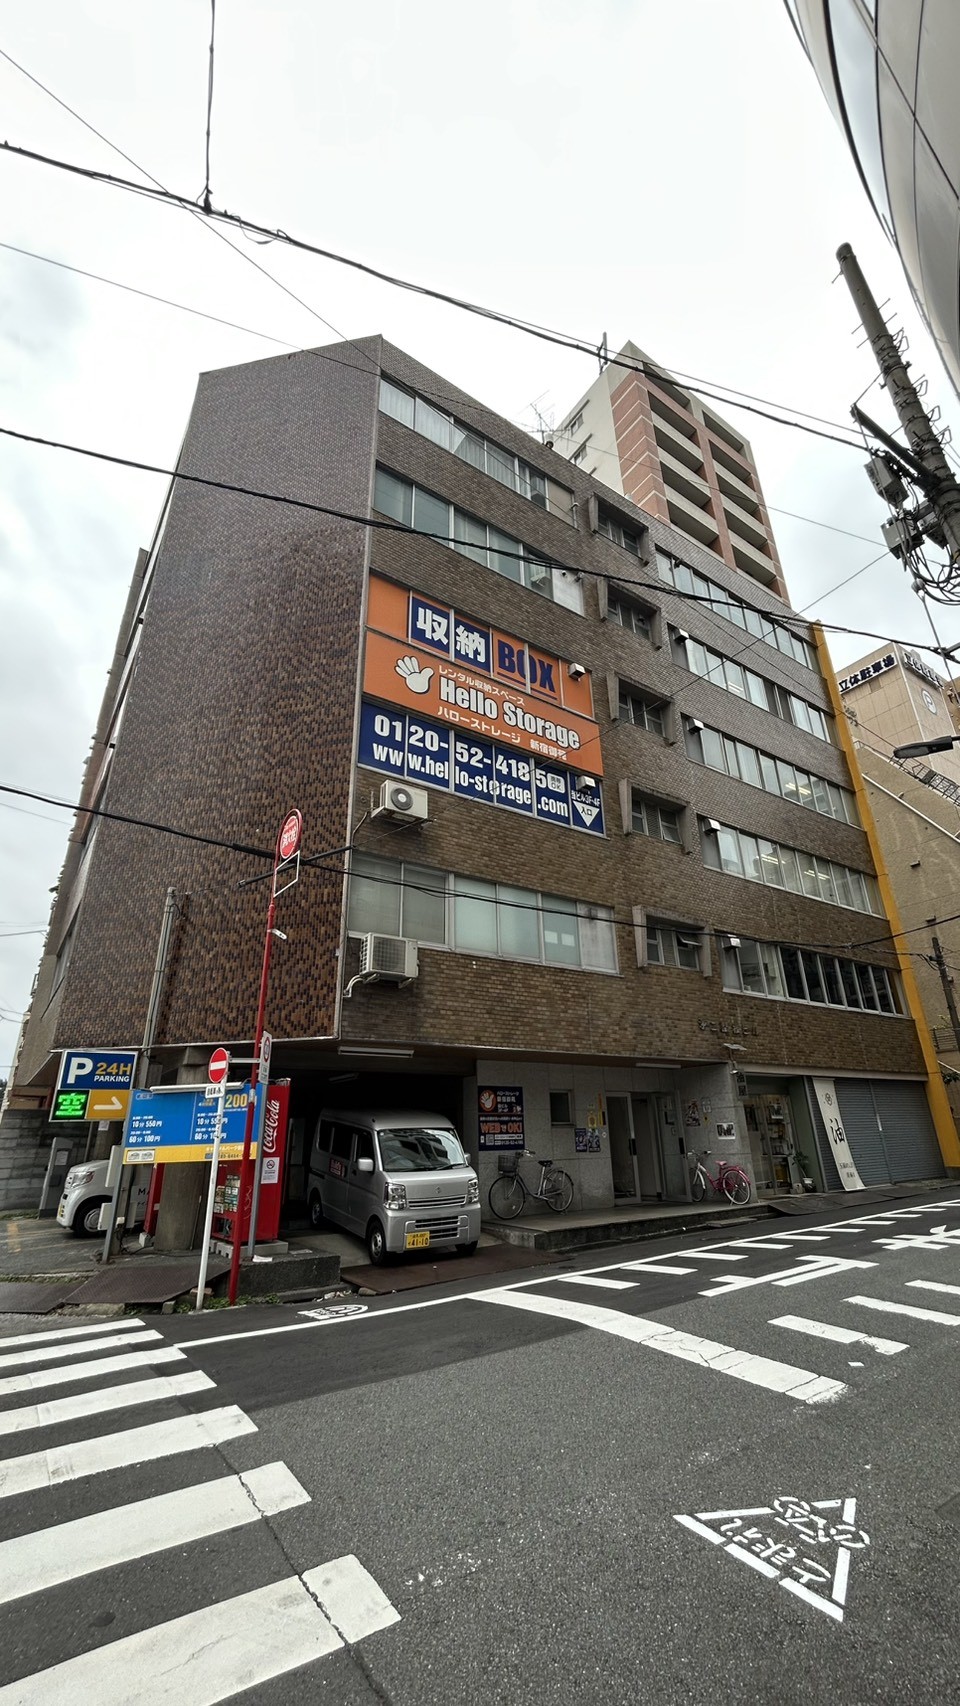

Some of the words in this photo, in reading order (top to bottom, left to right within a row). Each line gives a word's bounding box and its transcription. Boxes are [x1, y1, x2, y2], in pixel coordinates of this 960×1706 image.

[416, 606, 486, 664] 収納
[497, 638, 557, 694] BOX
[439, 664, 526, 706] レンタル収納スペース
[437, 705, 522, 745] ハローストレージ
[438, 676, 498, 721] Hello
[502, 700, 581, 749] Storage
[374, 714, 547, 788] 0120-52-4185
[372, 743, 569, 818] www.hello-storage.com
[550, 782, 562, 791] OK
[581, 806, 593, 817] 入口
[66, 1057, 93, 1084] P
[95, 1062, 132, 1075] 24H
[55, 1092, 87, 1116] 空
[225, 1093, 256, 1108] 200
[411, 1237, 429, 1246] 41-10
